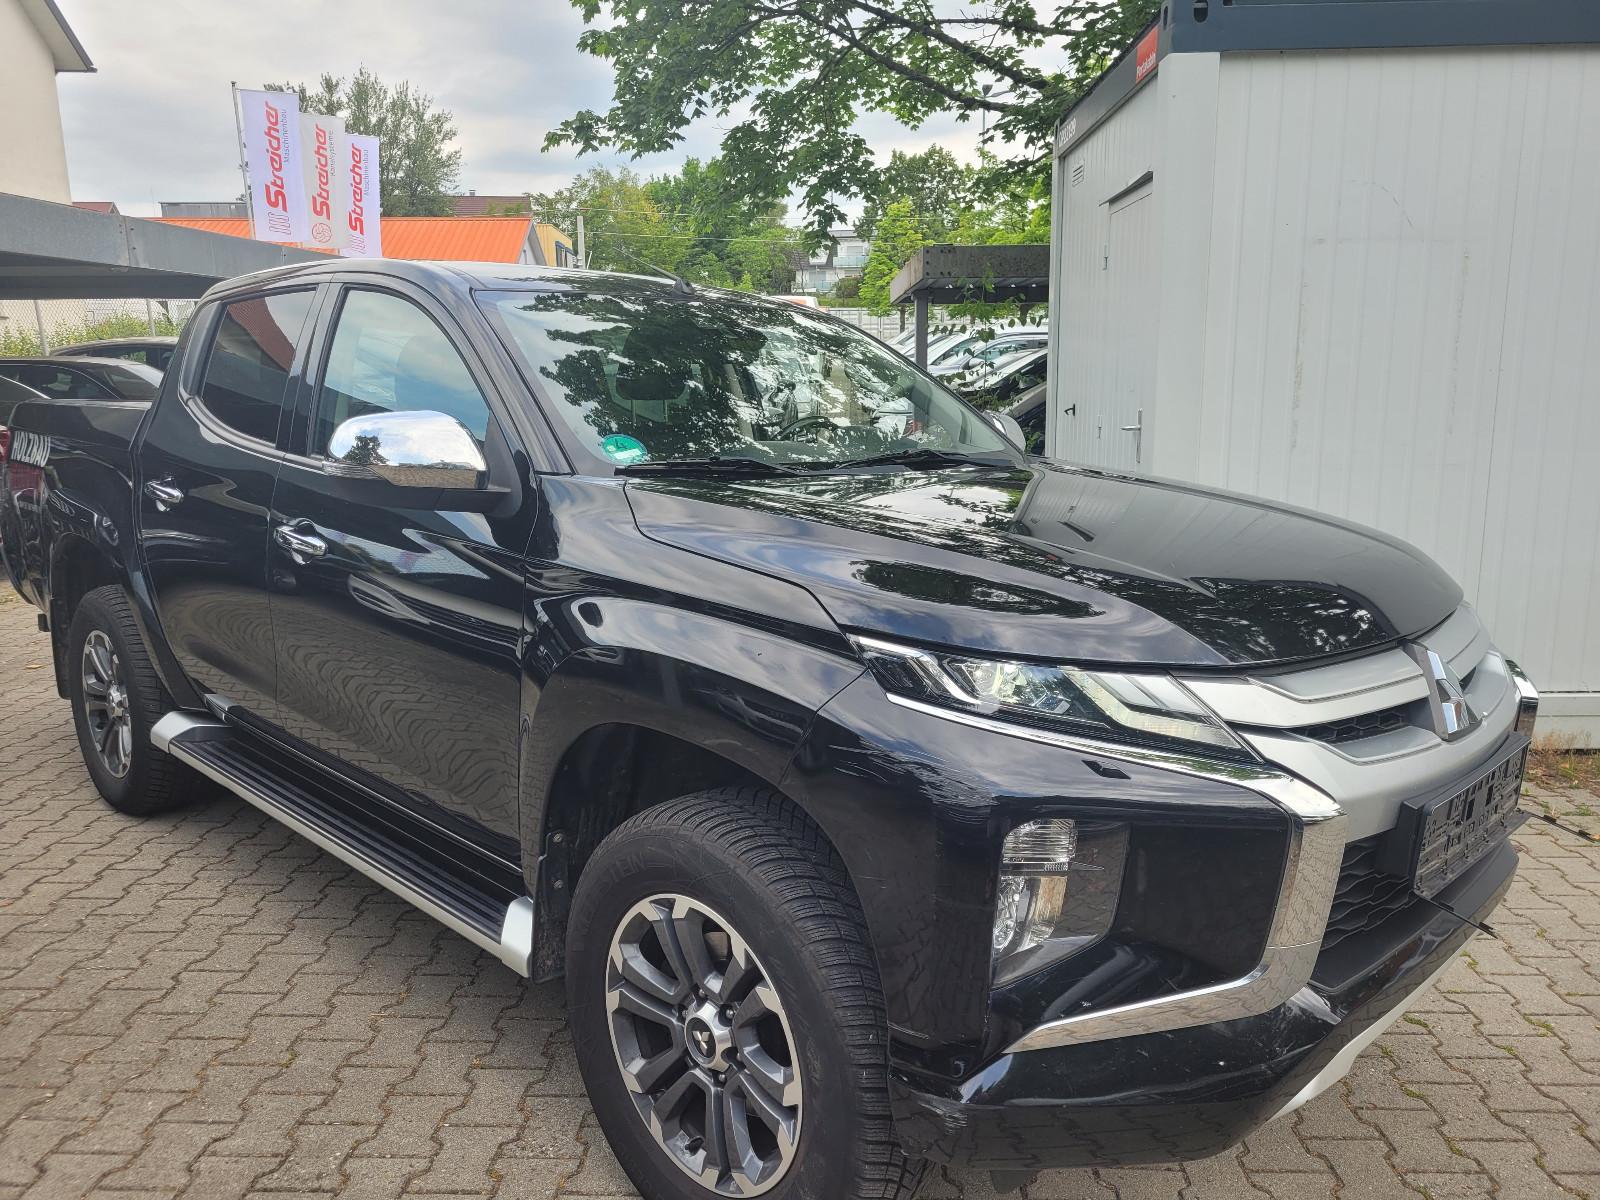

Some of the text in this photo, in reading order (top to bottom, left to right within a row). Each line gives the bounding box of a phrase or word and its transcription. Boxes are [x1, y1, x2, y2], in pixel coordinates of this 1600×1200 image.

[265, 101, 288, 213] Streicher
[312, 122, 331, 220] Streicher
[349, 142, 364, 236] Streicher
[11, 430, 51, 468] HOLZBAU
